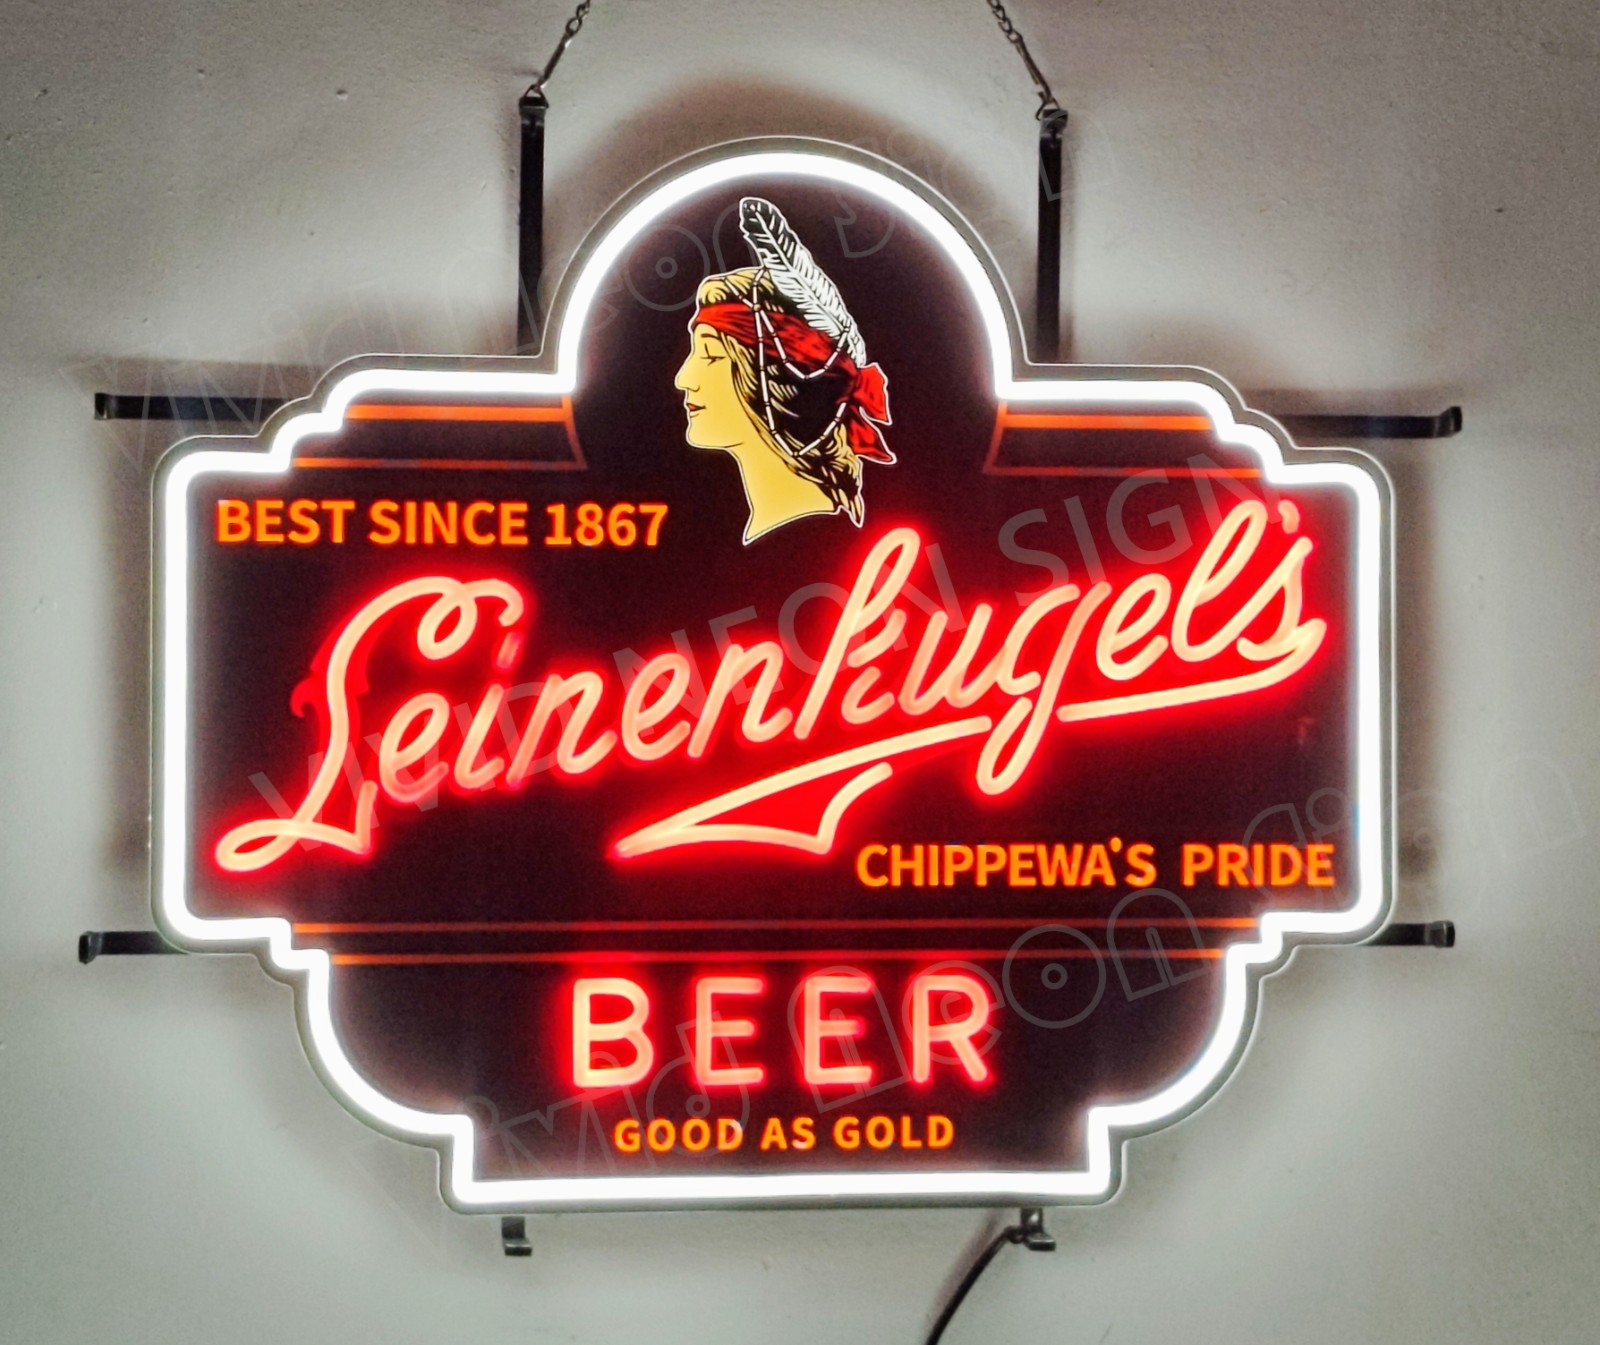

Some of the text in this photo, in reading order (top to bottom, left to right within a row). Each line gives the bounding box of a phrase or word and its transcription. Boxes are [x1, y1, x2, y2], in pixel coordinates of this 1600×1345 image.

[217, 499, 668, 547] BEST SINCE 1867
[857, 838, 1337, 888] CHIPPEWA'S PRIDE
[572, 974, 990, 1089] BEER
[614, 1115, 954, 1153] GOOD AS GOLD
